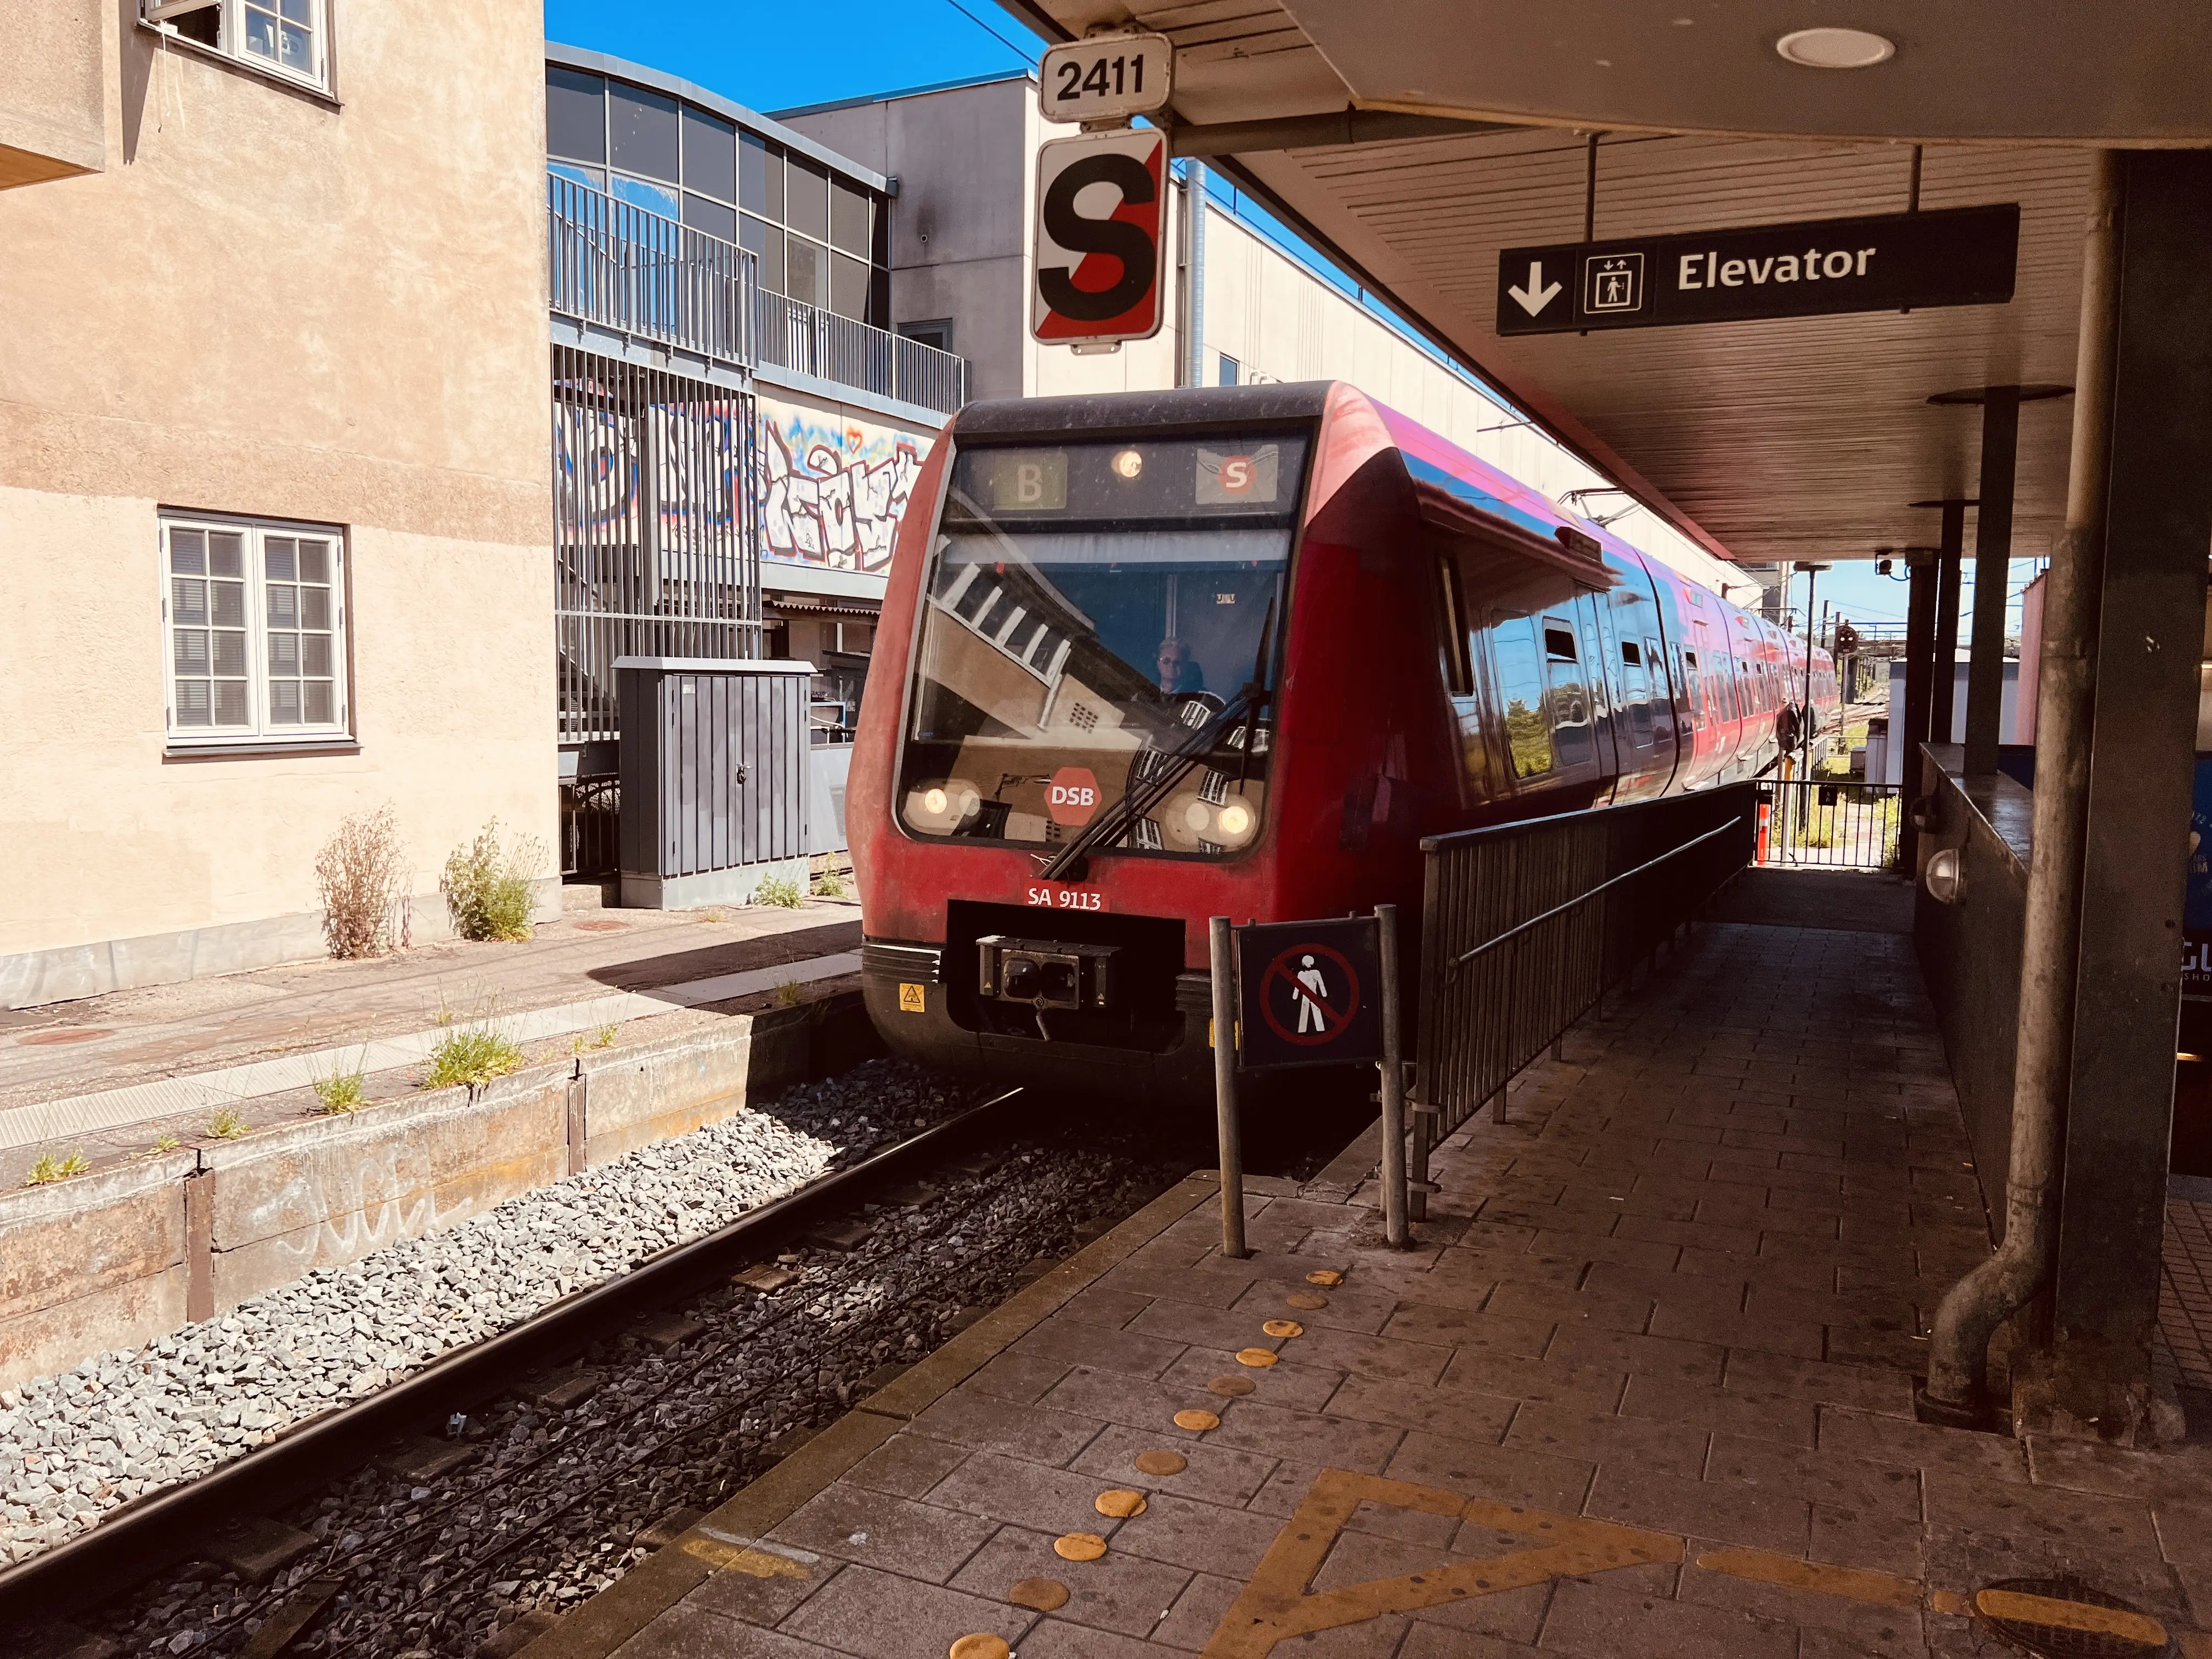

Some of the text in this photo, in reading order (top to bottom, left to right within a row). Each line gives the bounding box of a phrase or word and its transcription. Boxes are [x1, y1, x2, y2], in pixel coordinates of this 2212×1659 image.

[1057, 54, 1144, 101] 2411
[1038, 153, 1154, 321] S
[1679, 248, 1876, 290] Elevator
[1018, 464, 1042, 501] B
[1226, 462, 1248, 488] S
[1052, 786, 1094, 806] DSB
[1028, 888, 1101, 910] SA 9113
